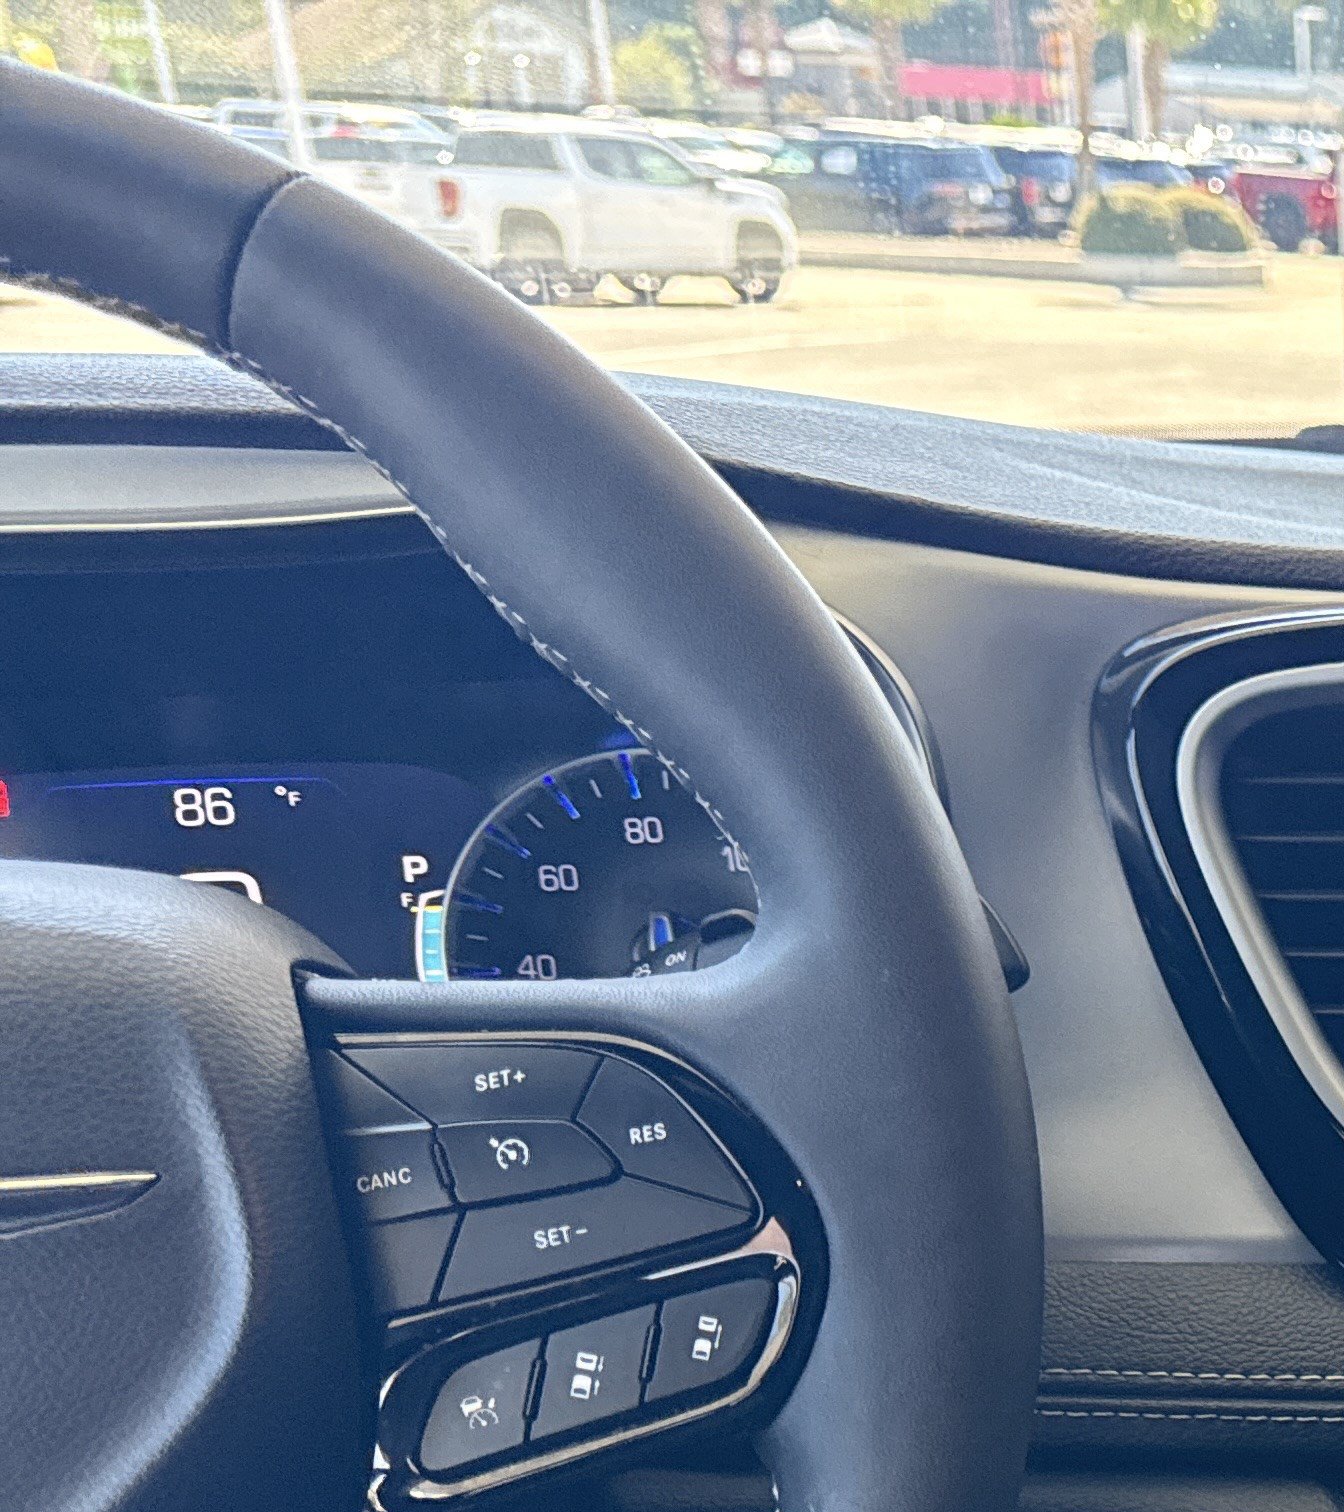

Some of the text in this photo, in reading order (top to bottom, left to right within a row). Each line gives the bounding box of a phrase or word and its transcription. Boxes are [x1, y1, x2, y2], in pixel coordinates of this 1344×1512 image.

[173, 787, 235, 827] 86
[624, 816, 663, 844] 80
[401, 856, 428, 883] P
[537, 864, 579, 892] 60
[401, 893, 414, 907] F
[517, 954, 557, 980] 40
[629, 1122, 667, 1145] RES
[356, 1167, 413, 1193] CANC
